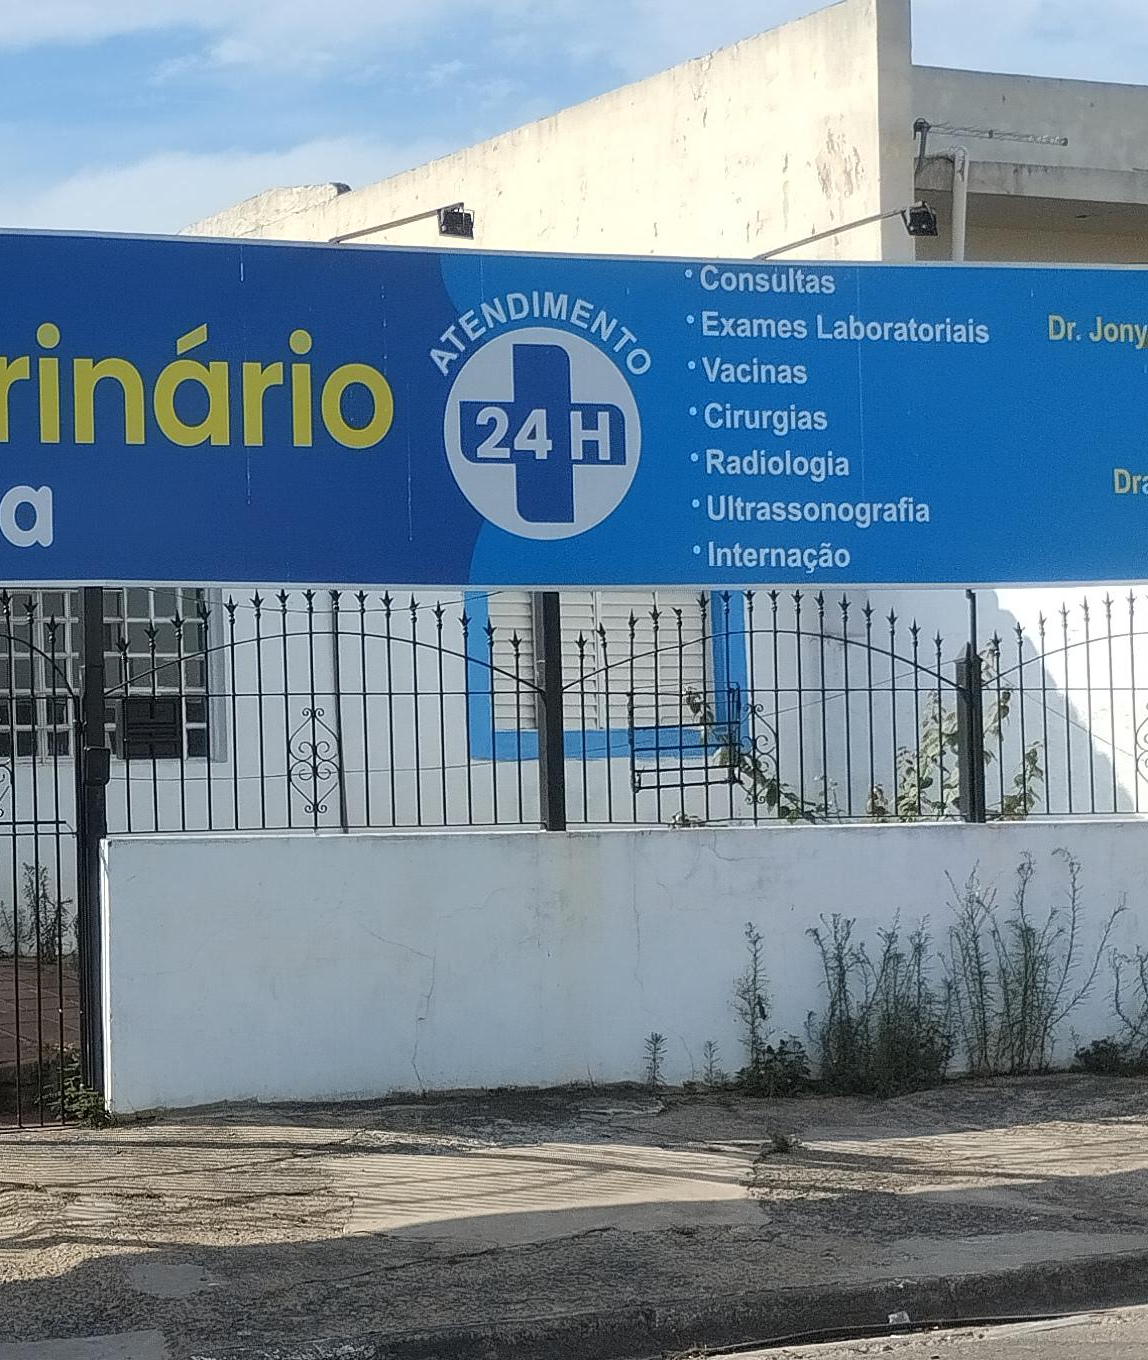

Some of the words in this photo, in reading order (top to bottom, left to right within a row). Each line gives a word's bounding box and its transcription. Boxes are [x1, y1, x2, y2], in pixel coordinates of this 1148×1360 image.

[699, 265, 836, 295] Consultas
[430, 291, 651, 378] ATENDIMENTO
[701, 311, 808, 340] Exames
[817, 314, 990, 344] Laboratoriais
[1048, 314, 1081, 341] Dr.
[702, 357, 808, 384] Vacinas
[475, 406, 553, 460] 24
[569, 410, 611, 461] H
[704, 402, 828, 436] Cirurgias
[706, 448, 850, 481] Radiologia
[707, 495, 930, 529] Ultrassonografia
[708, 542, 851, 574] Internação
